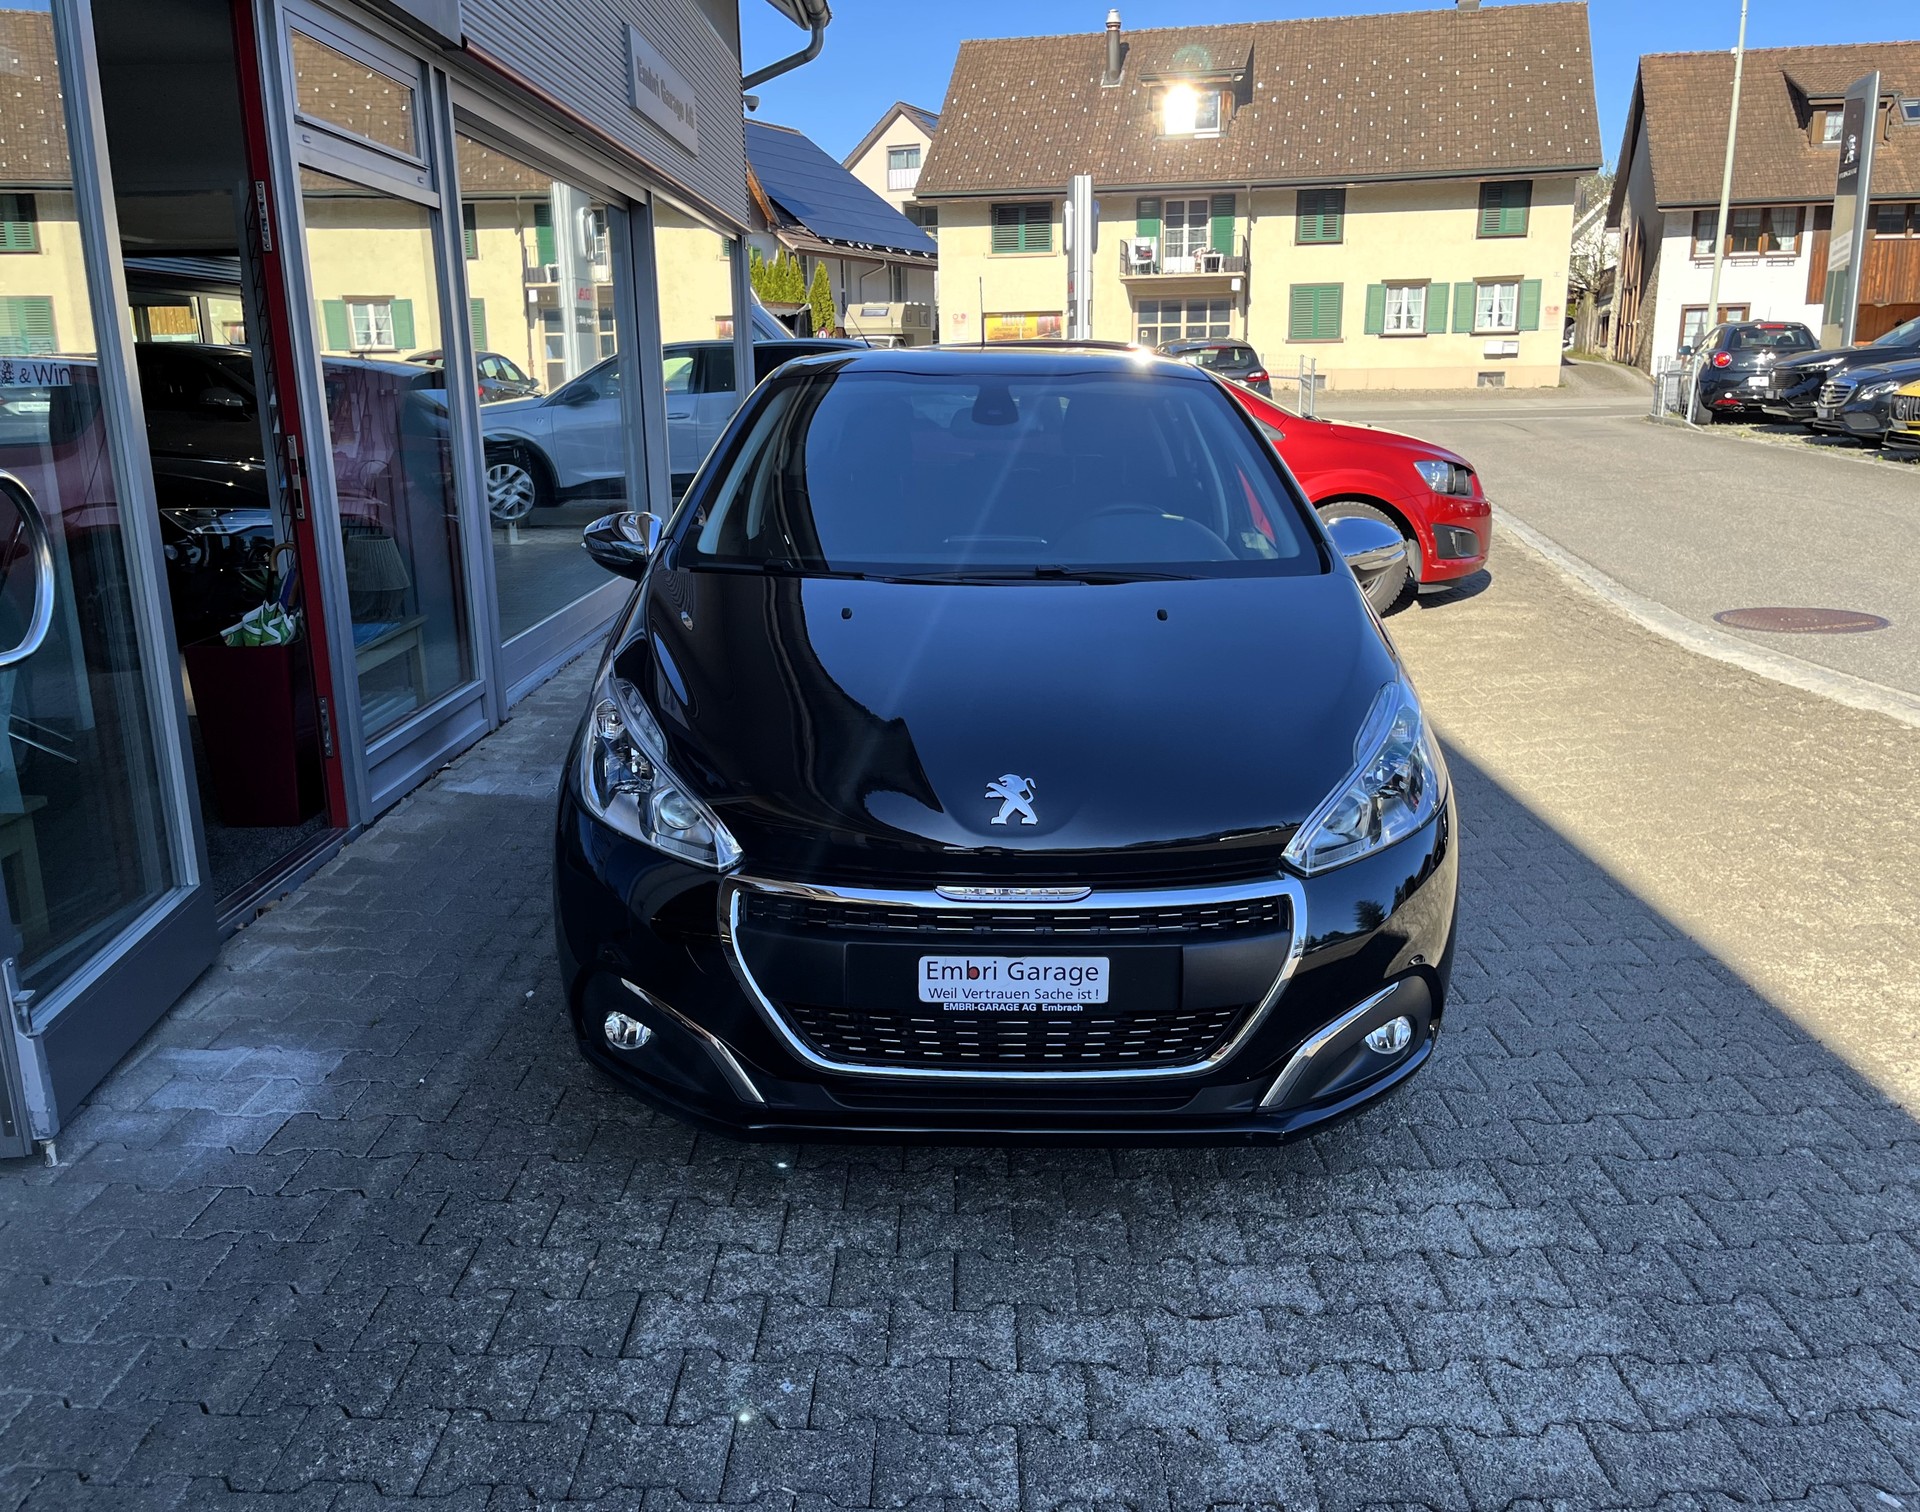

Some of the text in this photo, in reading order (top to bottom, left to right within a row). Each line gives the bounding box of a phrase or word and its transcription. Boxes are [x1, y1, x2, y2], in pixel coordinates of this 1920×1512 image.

[660, 79, 684, 122] Garage
[19, 362, 72, 386] & Win
[926, 960, 1099, 987] Embri Garage
[928, 987, 957, 999] Weil
[962, 987, 1030, 999] Vertrauen
[1034, 987, 1073, 1000] Sache
[943, 1002, 1083, 1012] EMBRI-GARAGE AG Embrach
